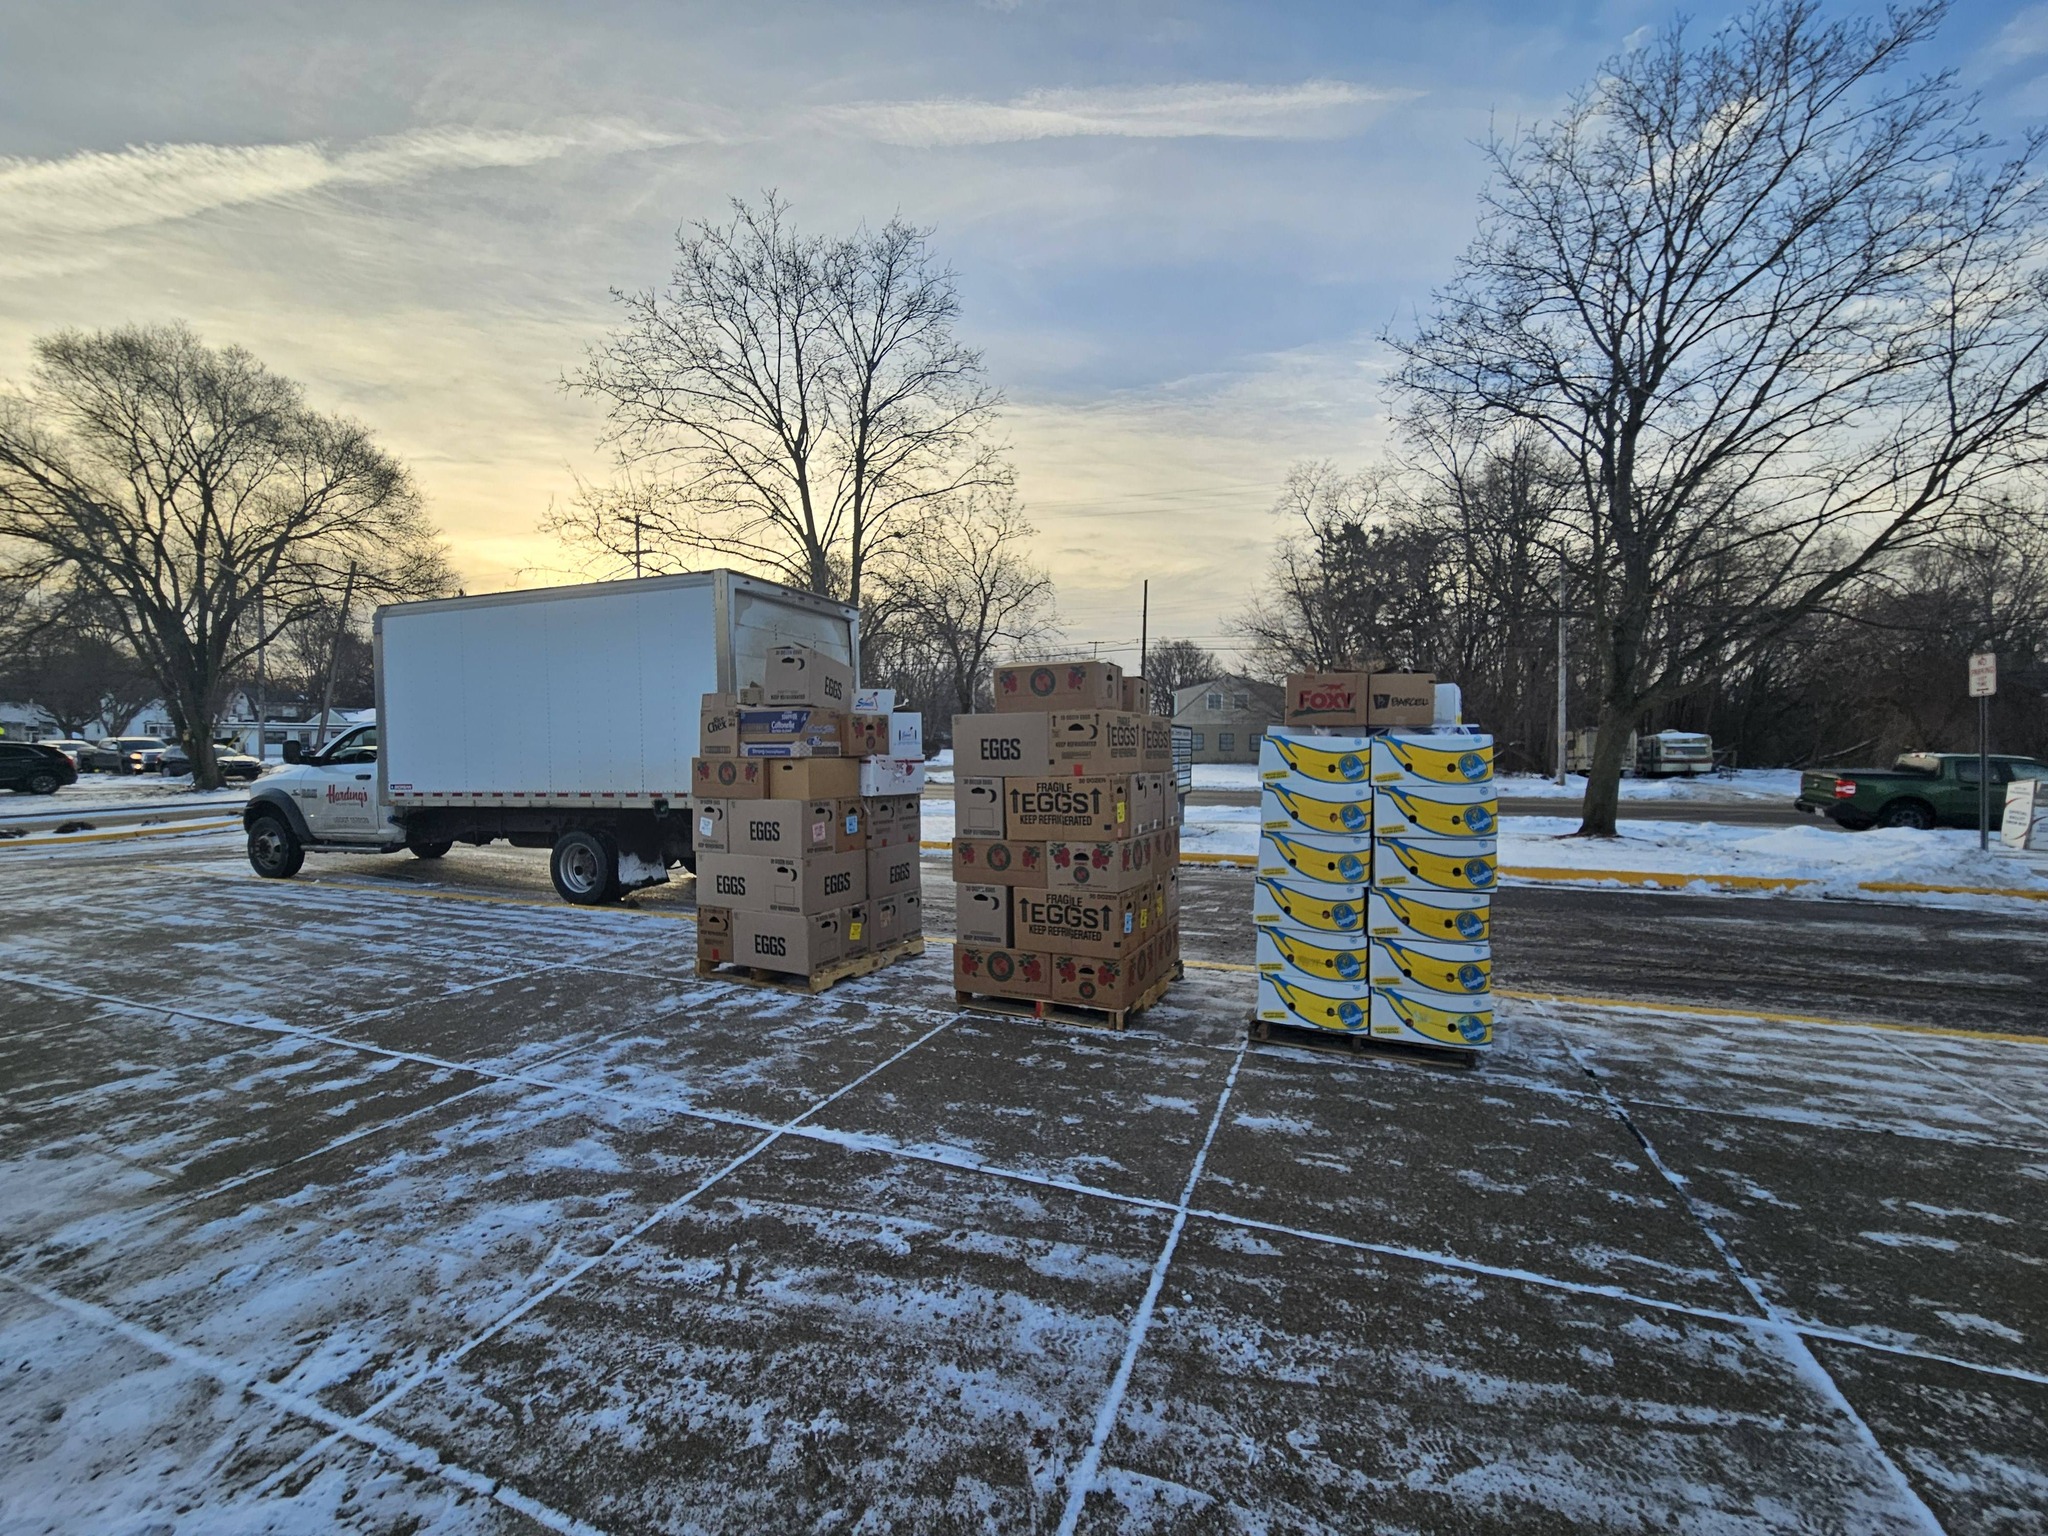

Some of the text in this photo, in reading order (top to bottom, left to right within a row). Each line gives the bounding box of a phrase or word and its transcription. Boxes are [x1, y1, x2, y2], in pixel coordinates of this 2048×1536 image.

[824, 675, 842, 701] EGGS
[1299, 690, 1357, 709] FOXY
[707, 720, 728, 733] Chex
[1111, 726, 1136, 748] EGGS
[980, 738, 1021, 761] EGGS
[1146, 730, 1169, 750] EGGS
[326, 784, 368, 808] Harding's
[1036, 782, 1072, 794] FRAGILE
[1021, 792, 1089, 815] EGGS
[749, 820, 781, 842] EGGS
[1020, 815, 1093, 826] KEEP REFRIGERATED
[716, 874, 746, 896] EGGS
[824, 871, 851, 896] EGGS
[889, 863, 911, 885] EGGS
[1046, 893, 1083, 908] FRAGILE
[1030, 903, 1099, 929] EGGS
[1028, 925, 1102, 941] KEEP REFRIGERATED
[754, 933, 787, 957] EGGS
